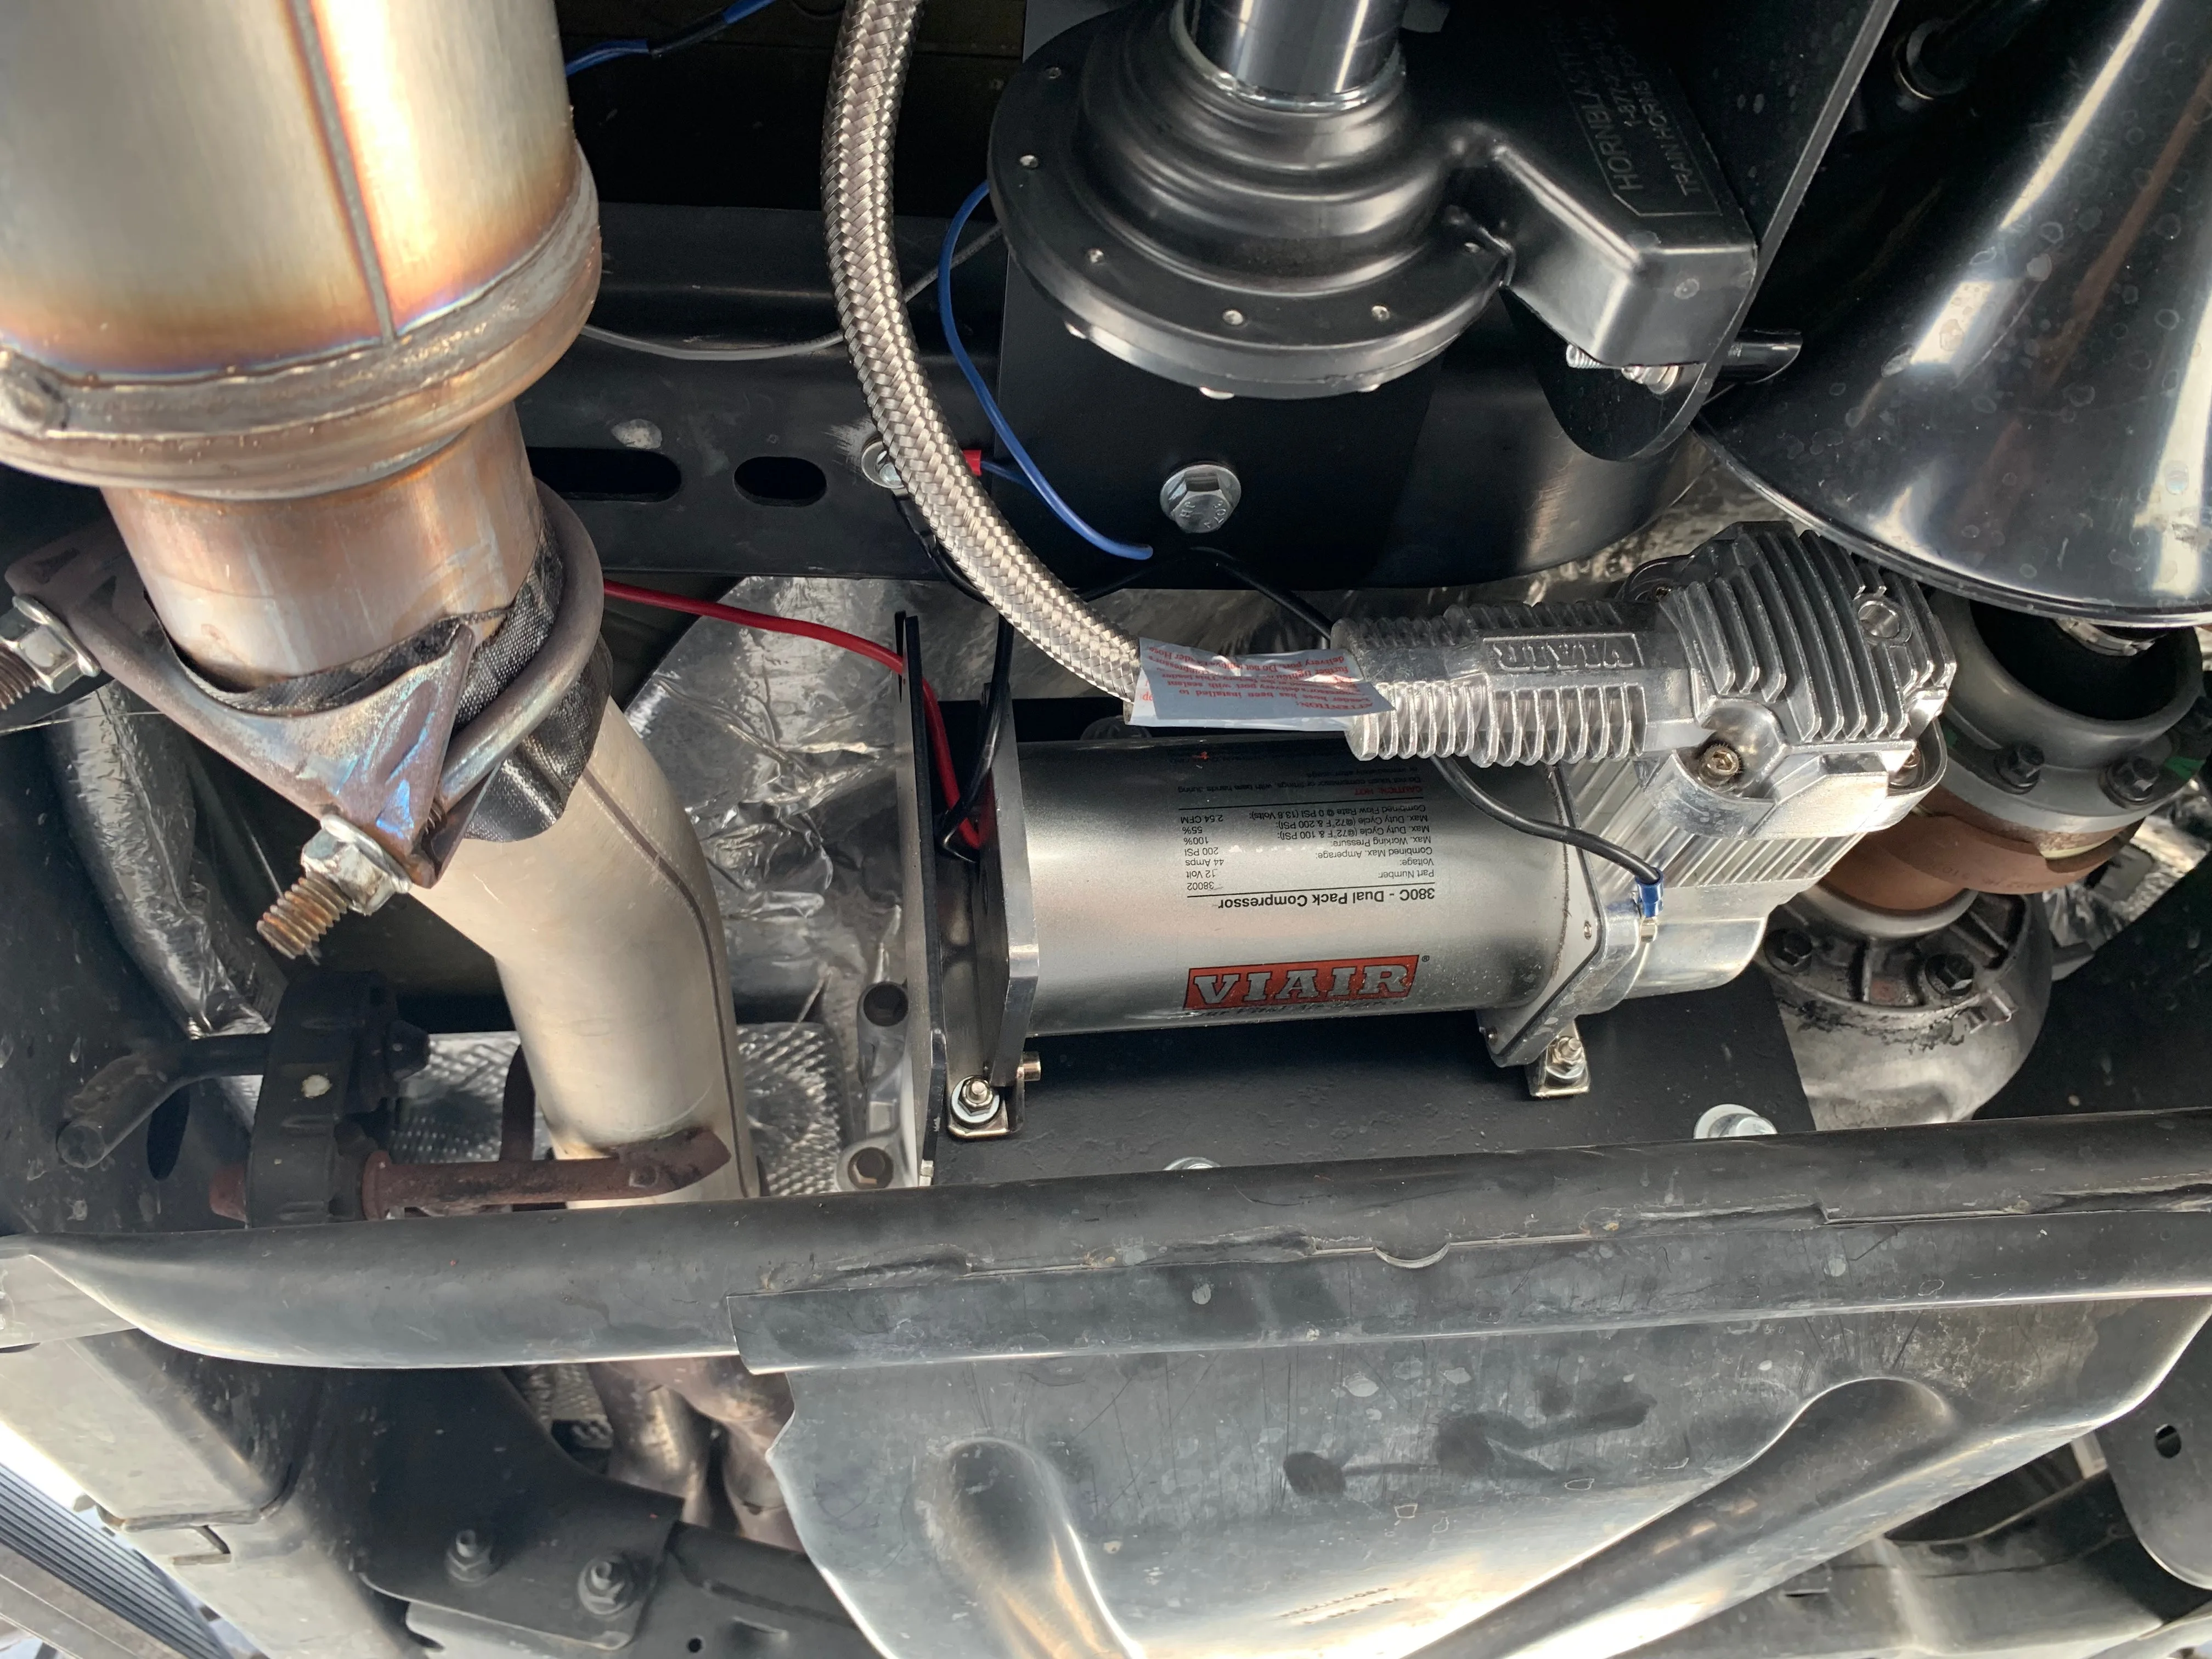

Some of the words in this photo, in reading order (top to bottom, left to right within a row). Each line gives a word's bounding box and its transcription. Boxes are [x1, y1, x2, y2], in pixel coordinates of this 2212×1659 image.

[1660, 143, 1702, 196] TRAIN
[1149, 647, 1172, 659] Hose
[1306, 656, 1344, 666] delivery
[1195, 690, 1242, 698] installed
[1382, 804, 1425, 814] Combined
[1204, 814, 1223, 822] 2.54
[1249, 811, 1276, 820] Volts):
[1278, 810, 1299, 819] (13.8
[1301, 810, 1317, 818] PSI
[1181, 816, 1201, 824] CFM
[1358, 816, 1383, 825] Cycle
[1385, 815, 1404, 823] Duty
[1299, 820, 1315, 828] 200
[1182, 826, 1203, 834] 55%
[1360, 826, 1384, 835] Cycle
[1386, 826, 1406, 834] Duty
[1300, 831, 1316, 839] 100
[1183, 837, 1209, 845] 100%
[1331, 837, 1371, 847] Pressure:
[1373, 836, 1408, 845] Working
[1410, 836, 1431, 844] Max.
[1184, 848, 1200, 856] PSI
[1202, 847, 1218, 855] 200
[1315, 850, 1362, 859] Amperage:
[1365, 848, 1386, 857] Max.
[1389, 847, 1433, 855] Combined
[1400, 857, 1434, 866] Voltage:
[1186, 870, 1203, 879] Volt
[1205, 869, 1216, 878] 12
[1417, 868, 1434, 877] Part
[1187, 881, 1215, 891] 38002
[1352, 890, 1384, 904] Dual
[1400, 888, 1435, 901] 380C
[1218, 894, 1308, 909] Compressor
[1312, 893, 1347, 906] Pack
[1193, 964, 1409, 1005] VIAIR
